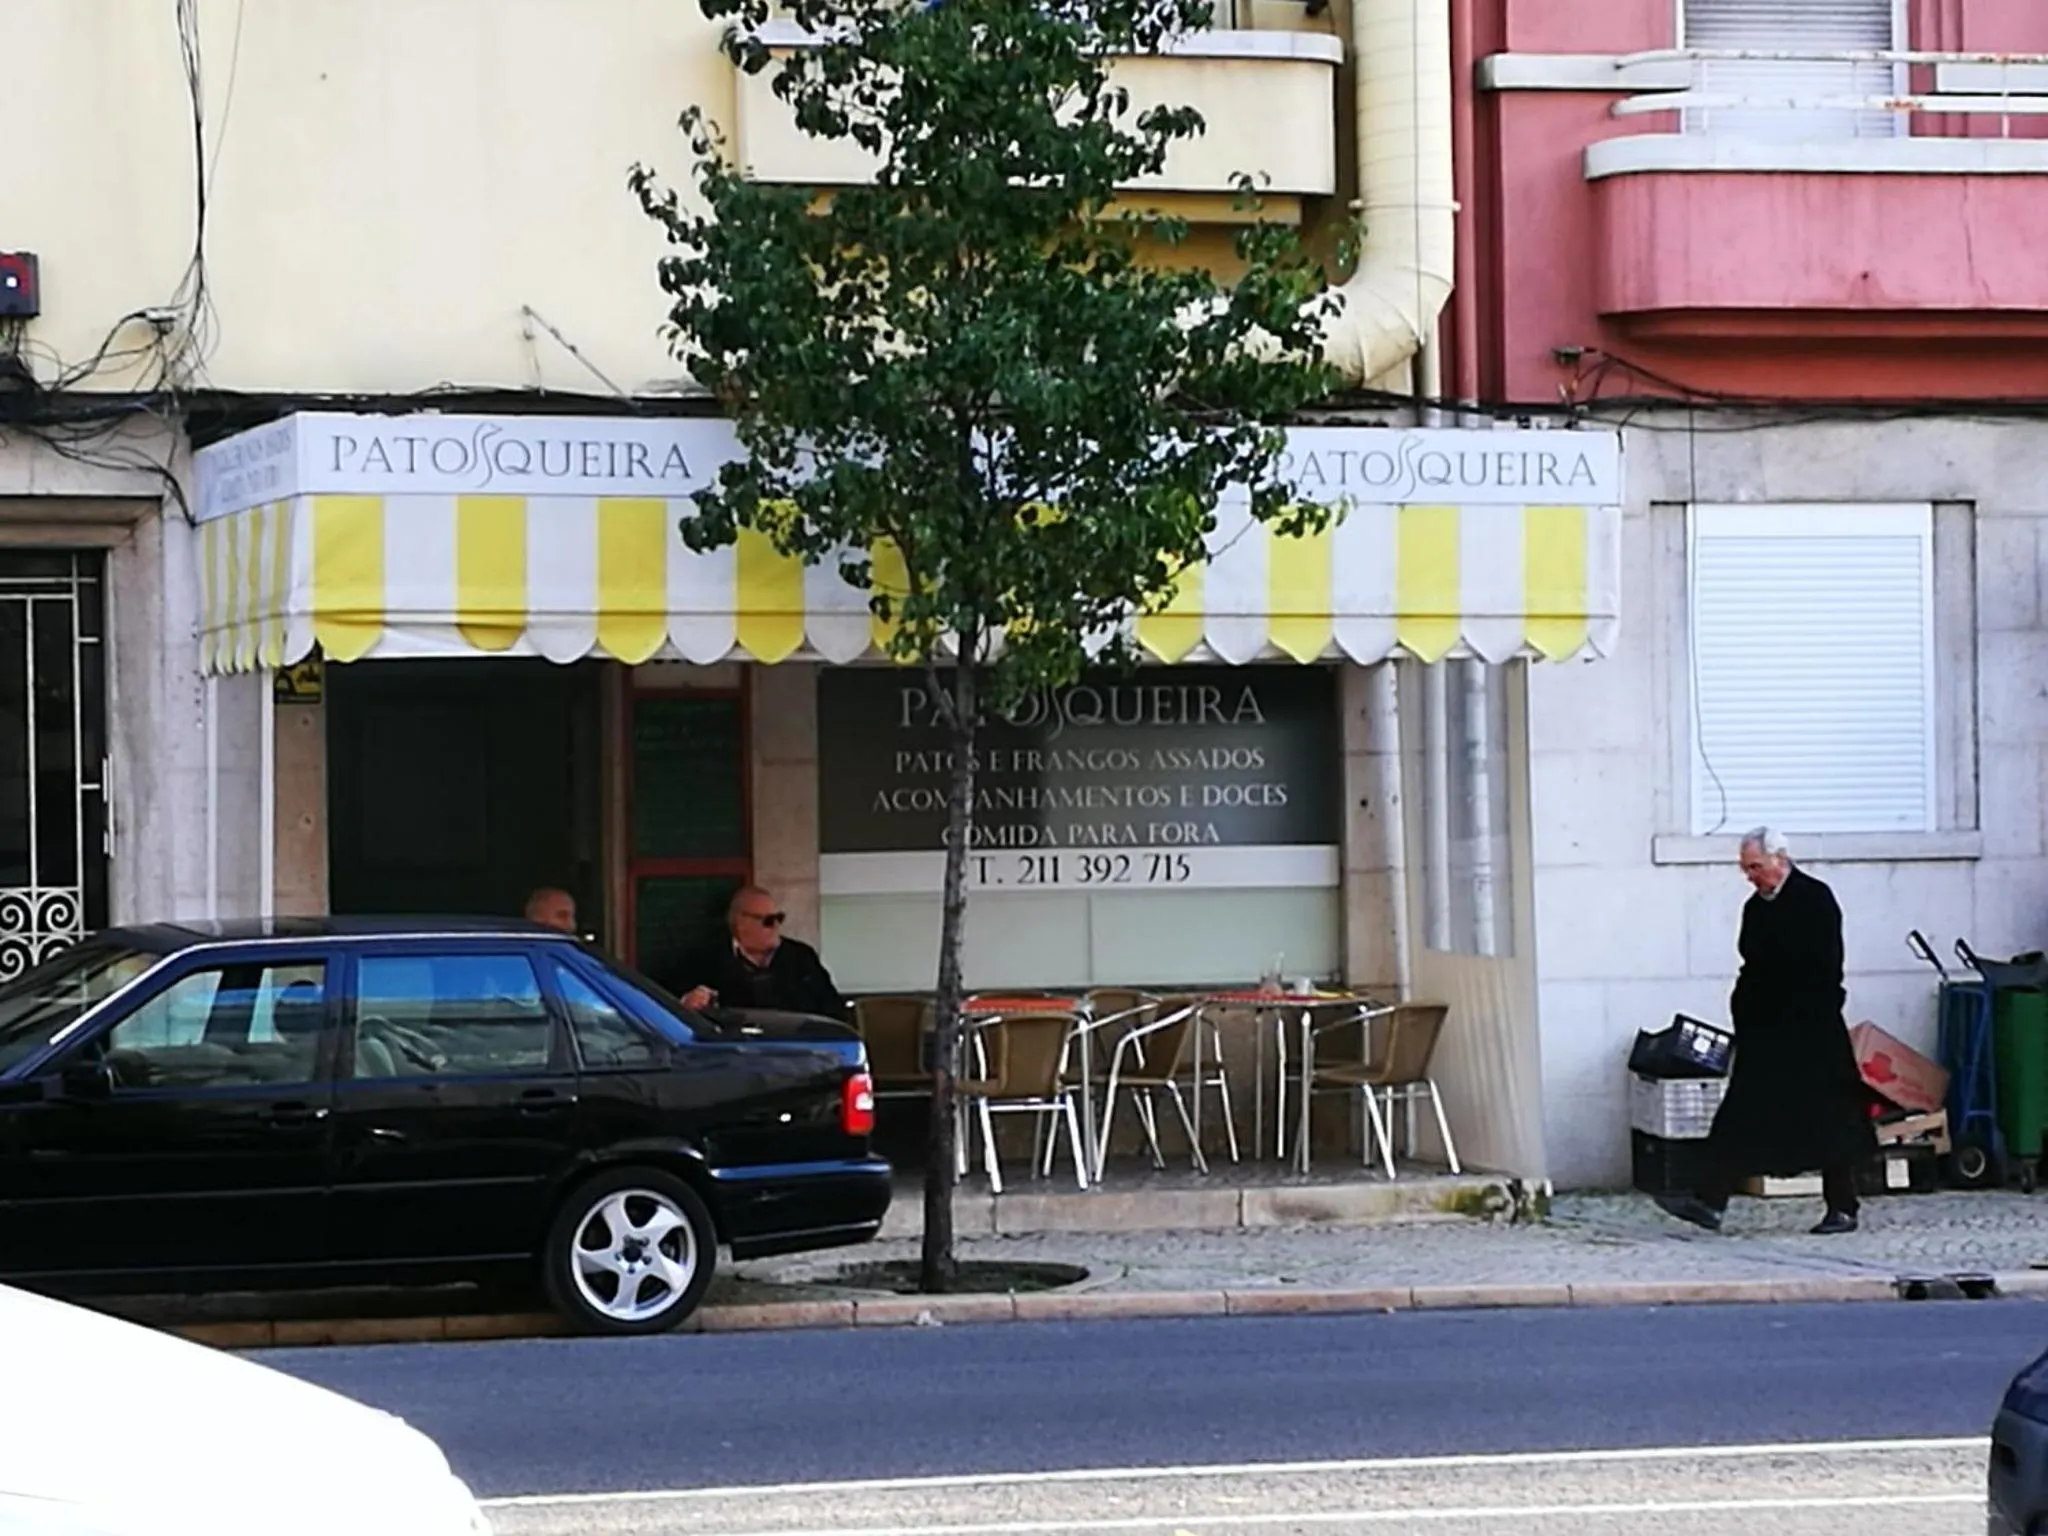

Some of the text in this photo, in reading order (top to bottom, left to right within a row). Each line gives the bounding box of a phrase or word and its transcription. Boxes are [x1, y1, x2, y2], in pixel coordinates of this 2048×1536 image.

[990, 750, 1002, 772] E
[1013, 749, 1140, 772] FRANGOS
[1150, 747, 1265, 770] ASSADOS
[873, 783, 1288, 811] ACOMANHAMENTOS E DOCES
[1068, 822, 1138, 845] PARA
[1148, 821, 1220, 844] FORA
[969, 852, 1192, 885] T. 211 392 715
